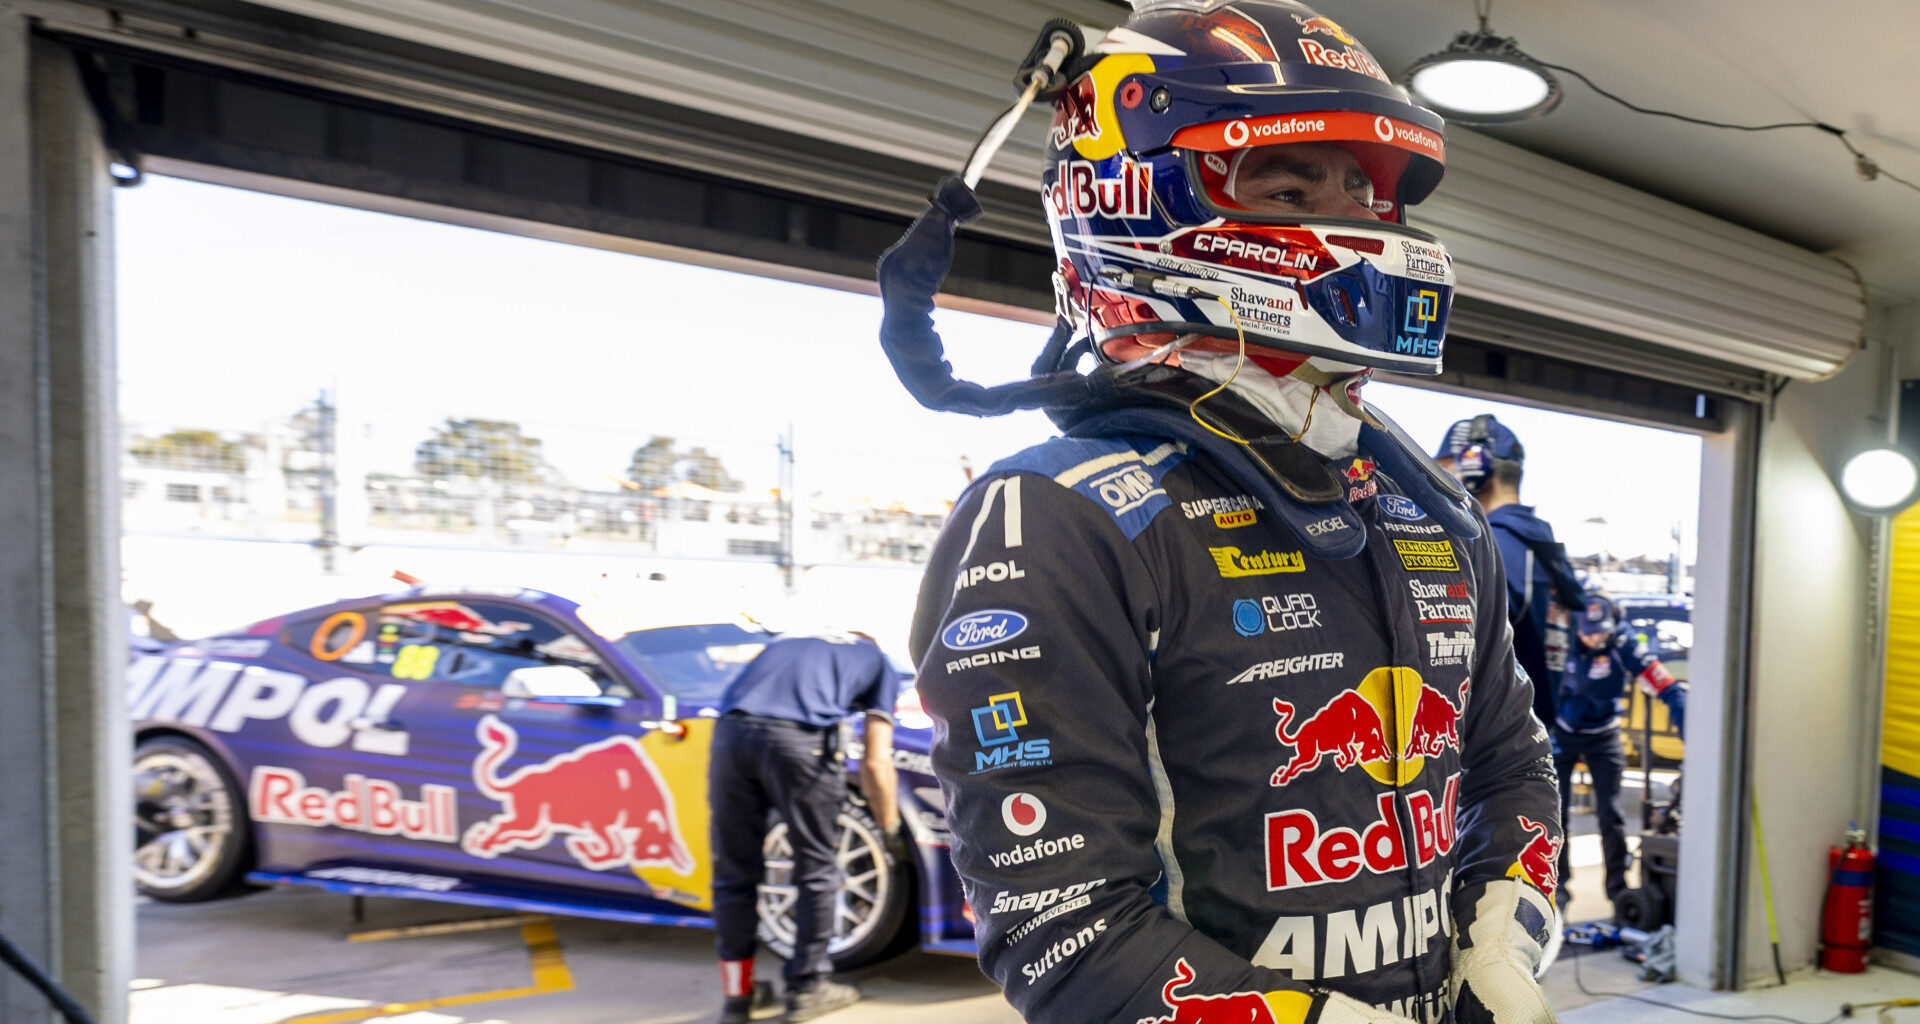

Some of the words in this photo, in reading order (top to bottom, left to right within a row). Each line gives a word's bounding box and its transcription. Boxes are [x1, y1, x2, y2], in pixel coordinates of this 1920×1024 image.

[1252, 118, 1325, 137] vodafone
[1395, 126, 1438, 151] vodafone
[1405, 253, 1445, 274] Partners
[1231, 301, 1291, 327] Partners
[1262, 322, 1290, 336] Services
[1395, 335, 1439, 355] MHS
[1099, 469, 1154, 508] OMP
[1386, 497, 1418, 517] Ford
[1219, 512, 1252, 525] AUTO
[1305, 516, 1349, 537] EXGEL
[1384, 521, 1445, 535] RACING
[1396, 541, 1450, 553] NATIONAL
[1211, 546, 1307, 577] Century
[1404, 555, 1455, 567] STORAGE
[954, 560, 1025, 591] MPOL
[1262, 593, 1316, 613] QUAD
[1415, 600, 1471, 620] Partners
[956, 615, 1007, 646] Ford
[1267, 610, 1322, 632] LOCK
[946, 646, 1041, 675] RACING
[1247, 652, 1344, 683] FREIGHTER
[1430, 658, 1443, 667] CAR
[1444, 657, 1462, 666] RENTAL
[974, 738, 1050, 771] MHS
[989, 833, 1085, 868] vodafone
[1045, 897, 1088, 919] EVENTS
[1022, 918, 1107, 986] Suttons
